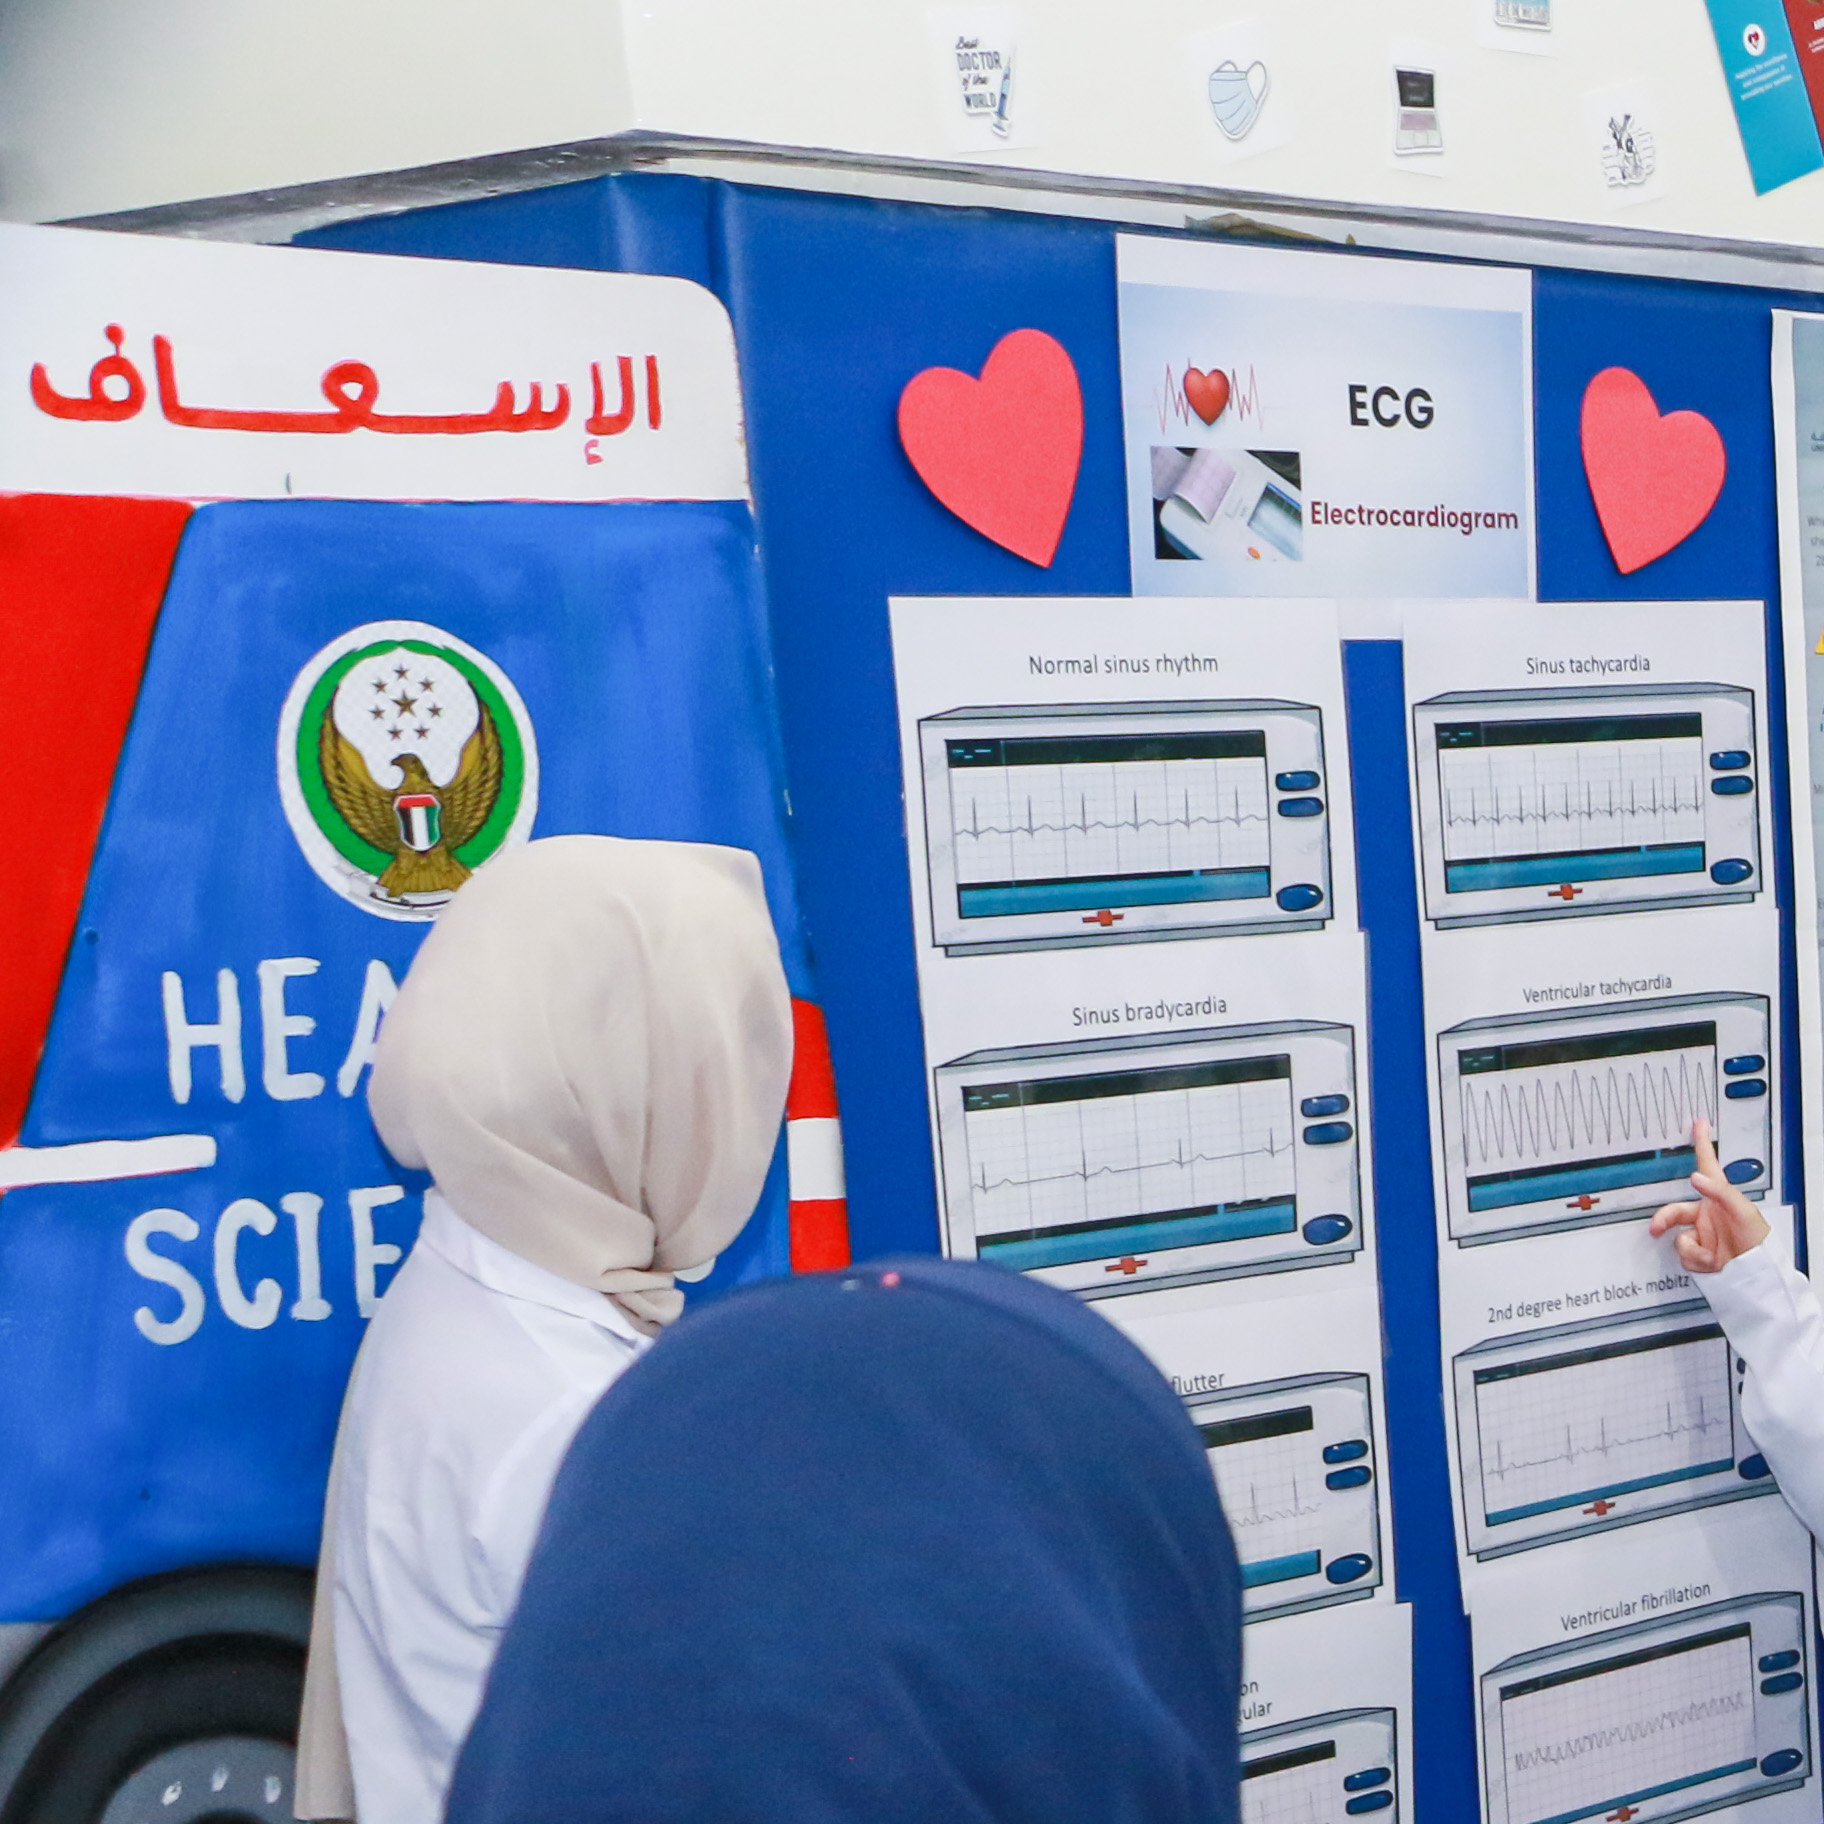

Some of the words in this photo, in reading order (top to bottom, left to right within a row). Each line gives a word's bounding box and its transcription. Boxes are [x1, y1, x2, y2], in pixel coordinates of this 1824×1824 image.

[957, 50, 1002, 71] DOCTOR
[964, 92, 997, 108] WORLD
[30, 322, 662, 465] الإسعاف
[1348, 384, 1434, 429] ECG
[1310, 500, 1518, 536] Electrocardiogram
[1028, 654, 1098, 674] Normal
[1104, 655, 1150, 674] sinus
[1156, 653, 1219, 677] rhythm
[1526, 657, 1565, 674] Sinus
[1569, 654, 1650, 676] tachycardia
[1522, 982, 1596, 1003] Ventricular
[1600, 973, 1672, 995] tachycardia
[1072, 1006, 1120, 1026] Sinus
[1125, 996, 1227, 1022] bradycardia
[162, 955, 402, 1104] HEA
[124, 1184, 404, 1345] SCIE
[1488, 1303, 1512, 1323] 2nd
[1516, 1297, 1562, 1318] degree
[1565, 1288, 1600, 1308] heart
[1603, 1281, 1642, 1301] block-
[1646, 1274, 1690, 1294] mobitz
[1171, 1373, 1224, 1394] flutter
[1560, 1600, 1638, 1632] Ventricular
[1641, 1583, 1711, 1612] fibrillation
